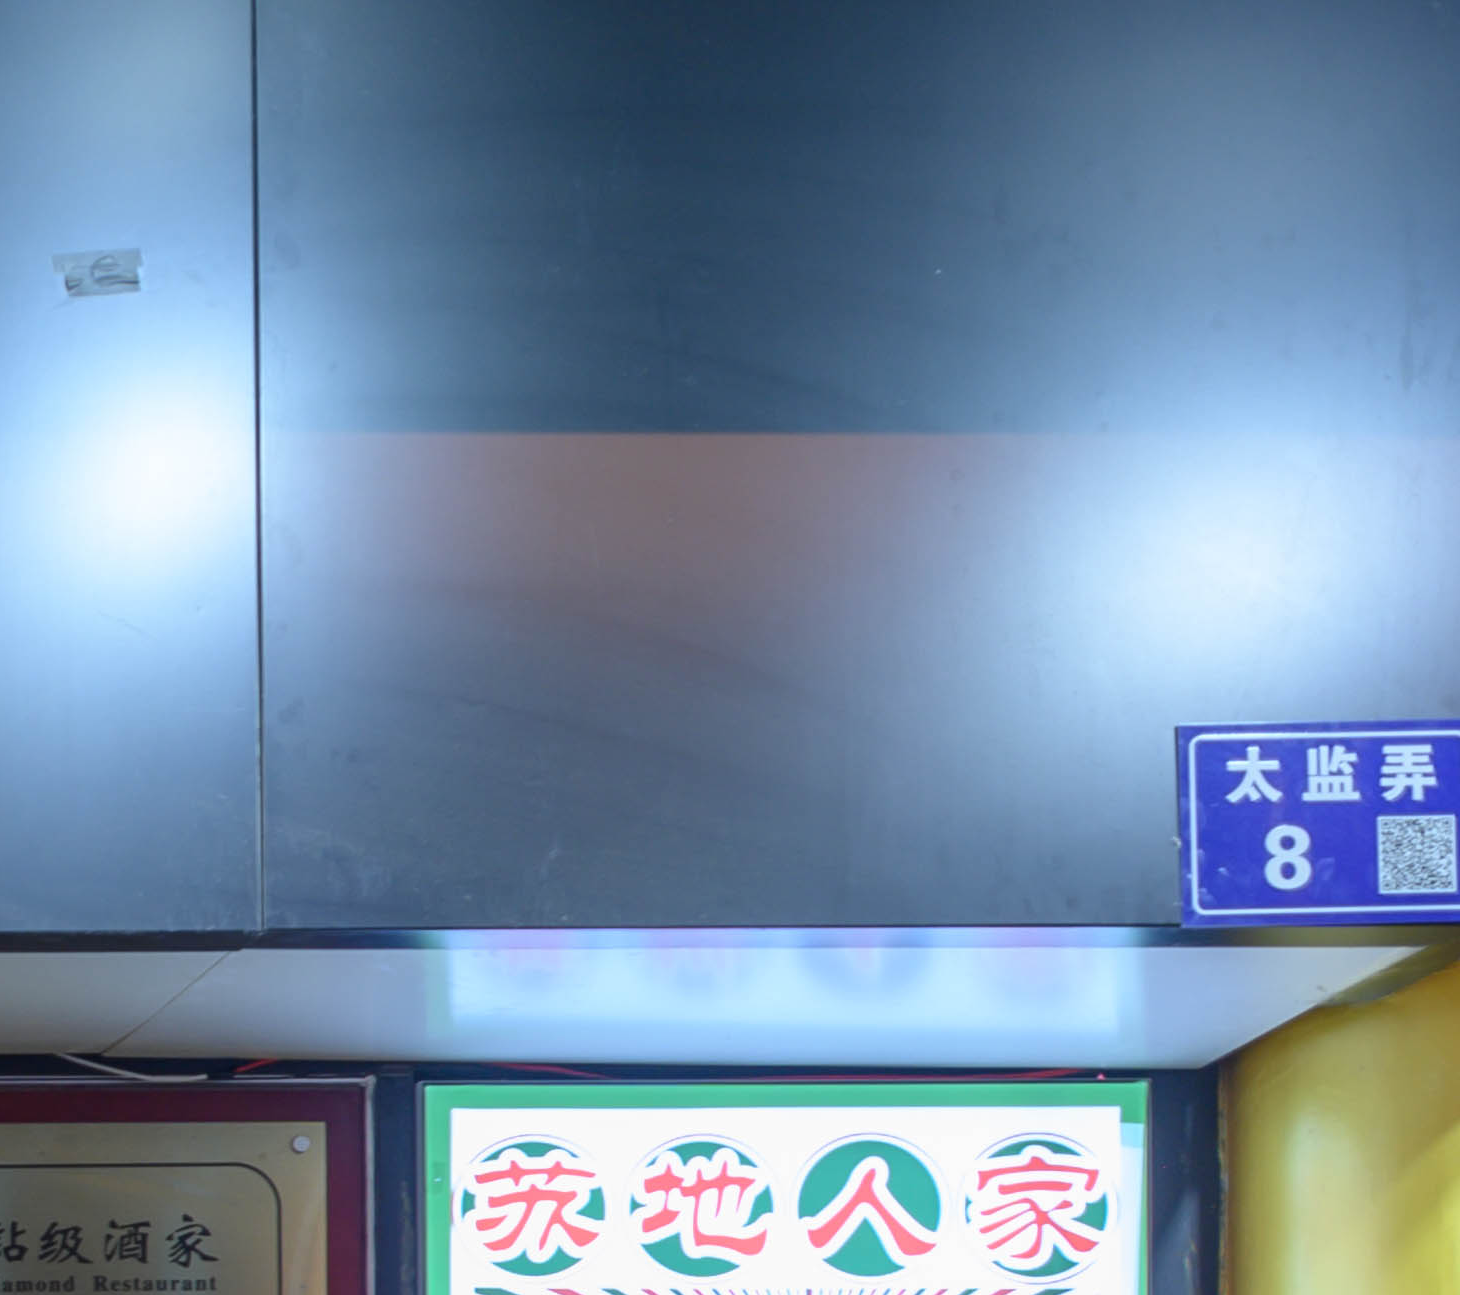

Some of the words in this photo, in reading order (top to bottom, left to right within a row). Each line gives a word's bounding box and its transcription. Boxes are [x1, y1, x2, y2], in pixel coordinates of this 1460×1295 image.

[1225, 743, 1437, 803] 太监弄
[1264, 824, 1312, 890] 8
[474, 1155, 1101, 1264] 苏地人家
[94, 1274, 217, 1293] Restaurant
